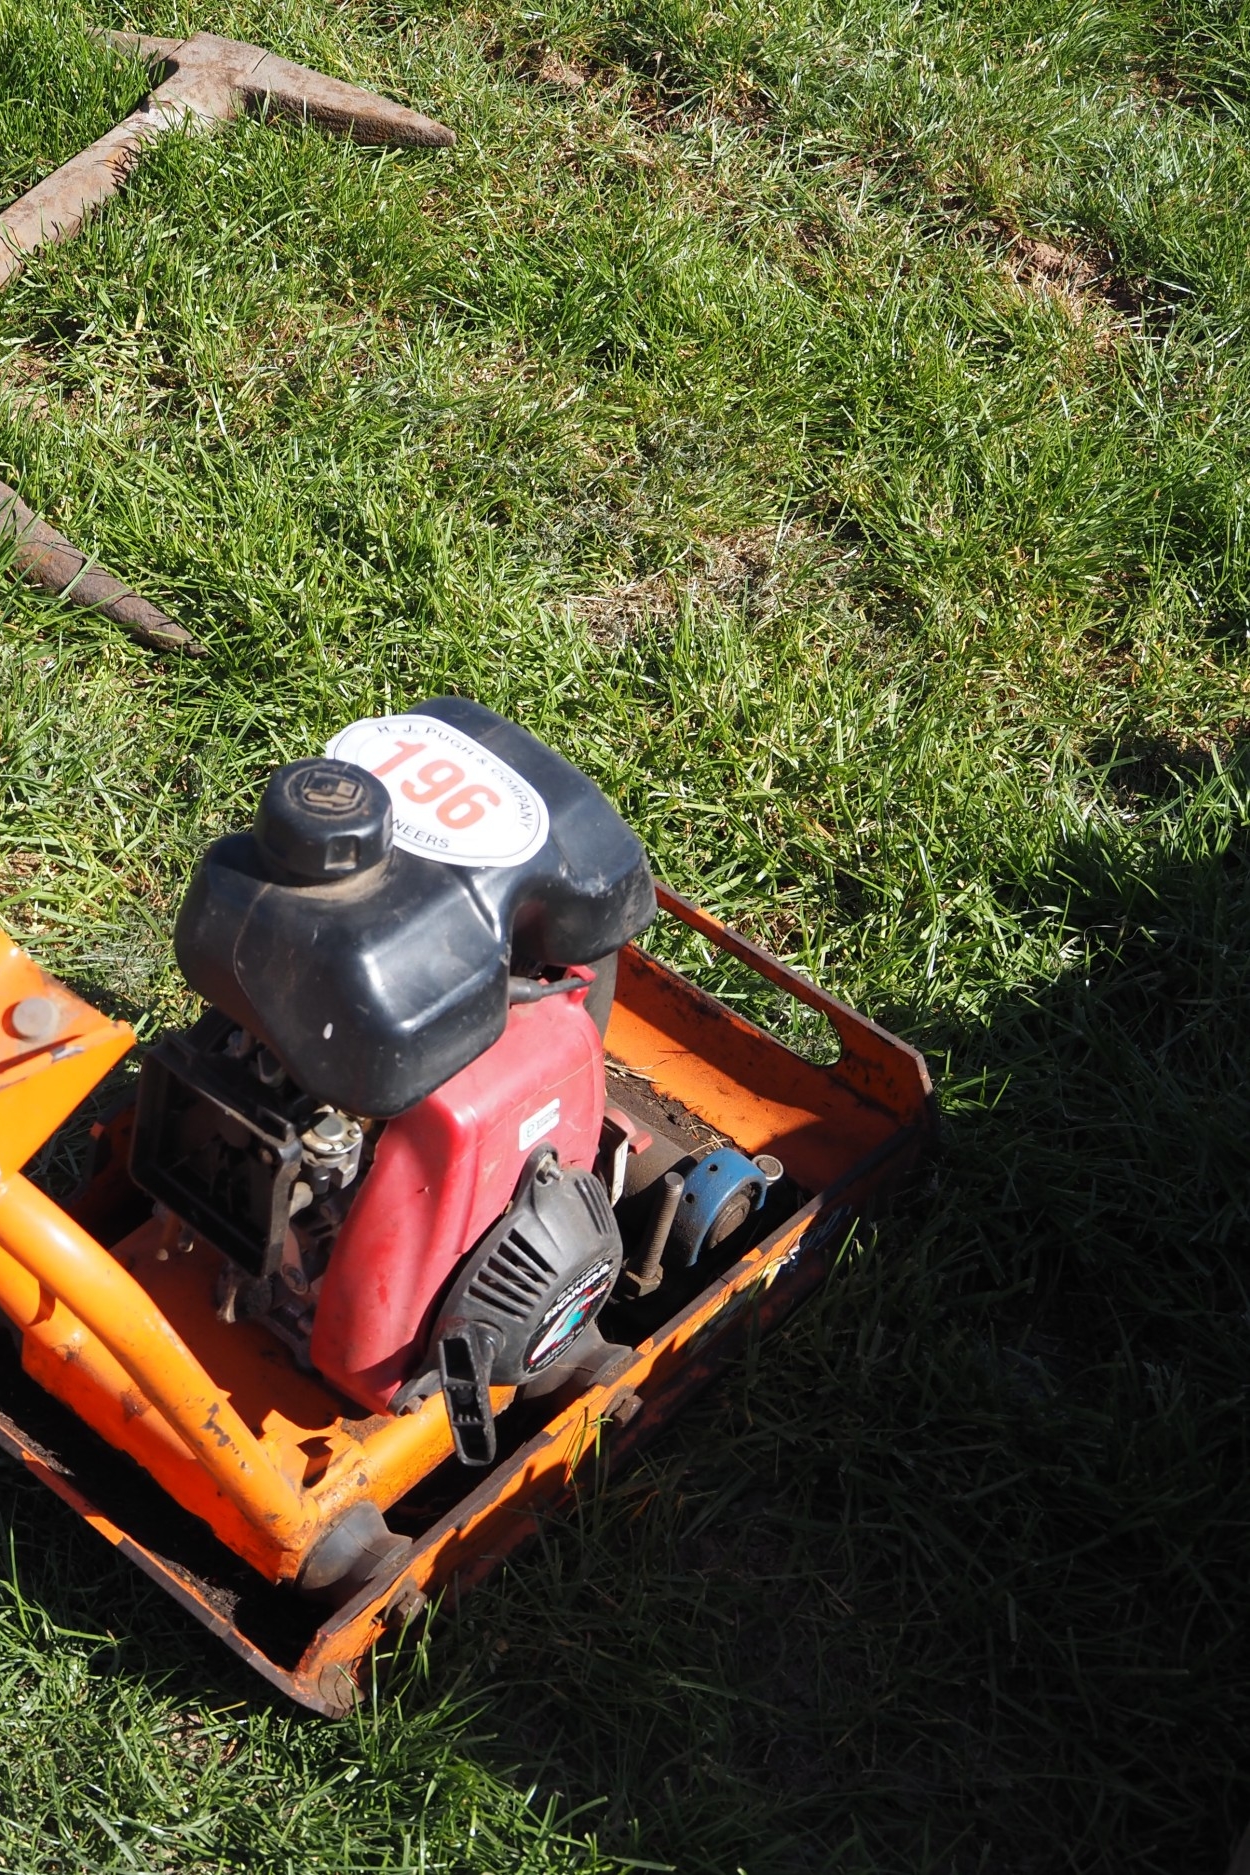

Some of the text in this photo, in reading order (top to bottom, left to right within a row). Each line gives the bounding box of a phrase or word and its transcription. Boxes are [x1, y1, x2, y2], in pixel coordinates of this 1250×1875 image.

[370, 740, 501, 830] 196
[425, 726, 474, 755] PUGH
[491, 768, 533, 831] COMPANY
[392, 818, 450, 849] NEERS
[542, 1264, 610, 1324] HONDA
